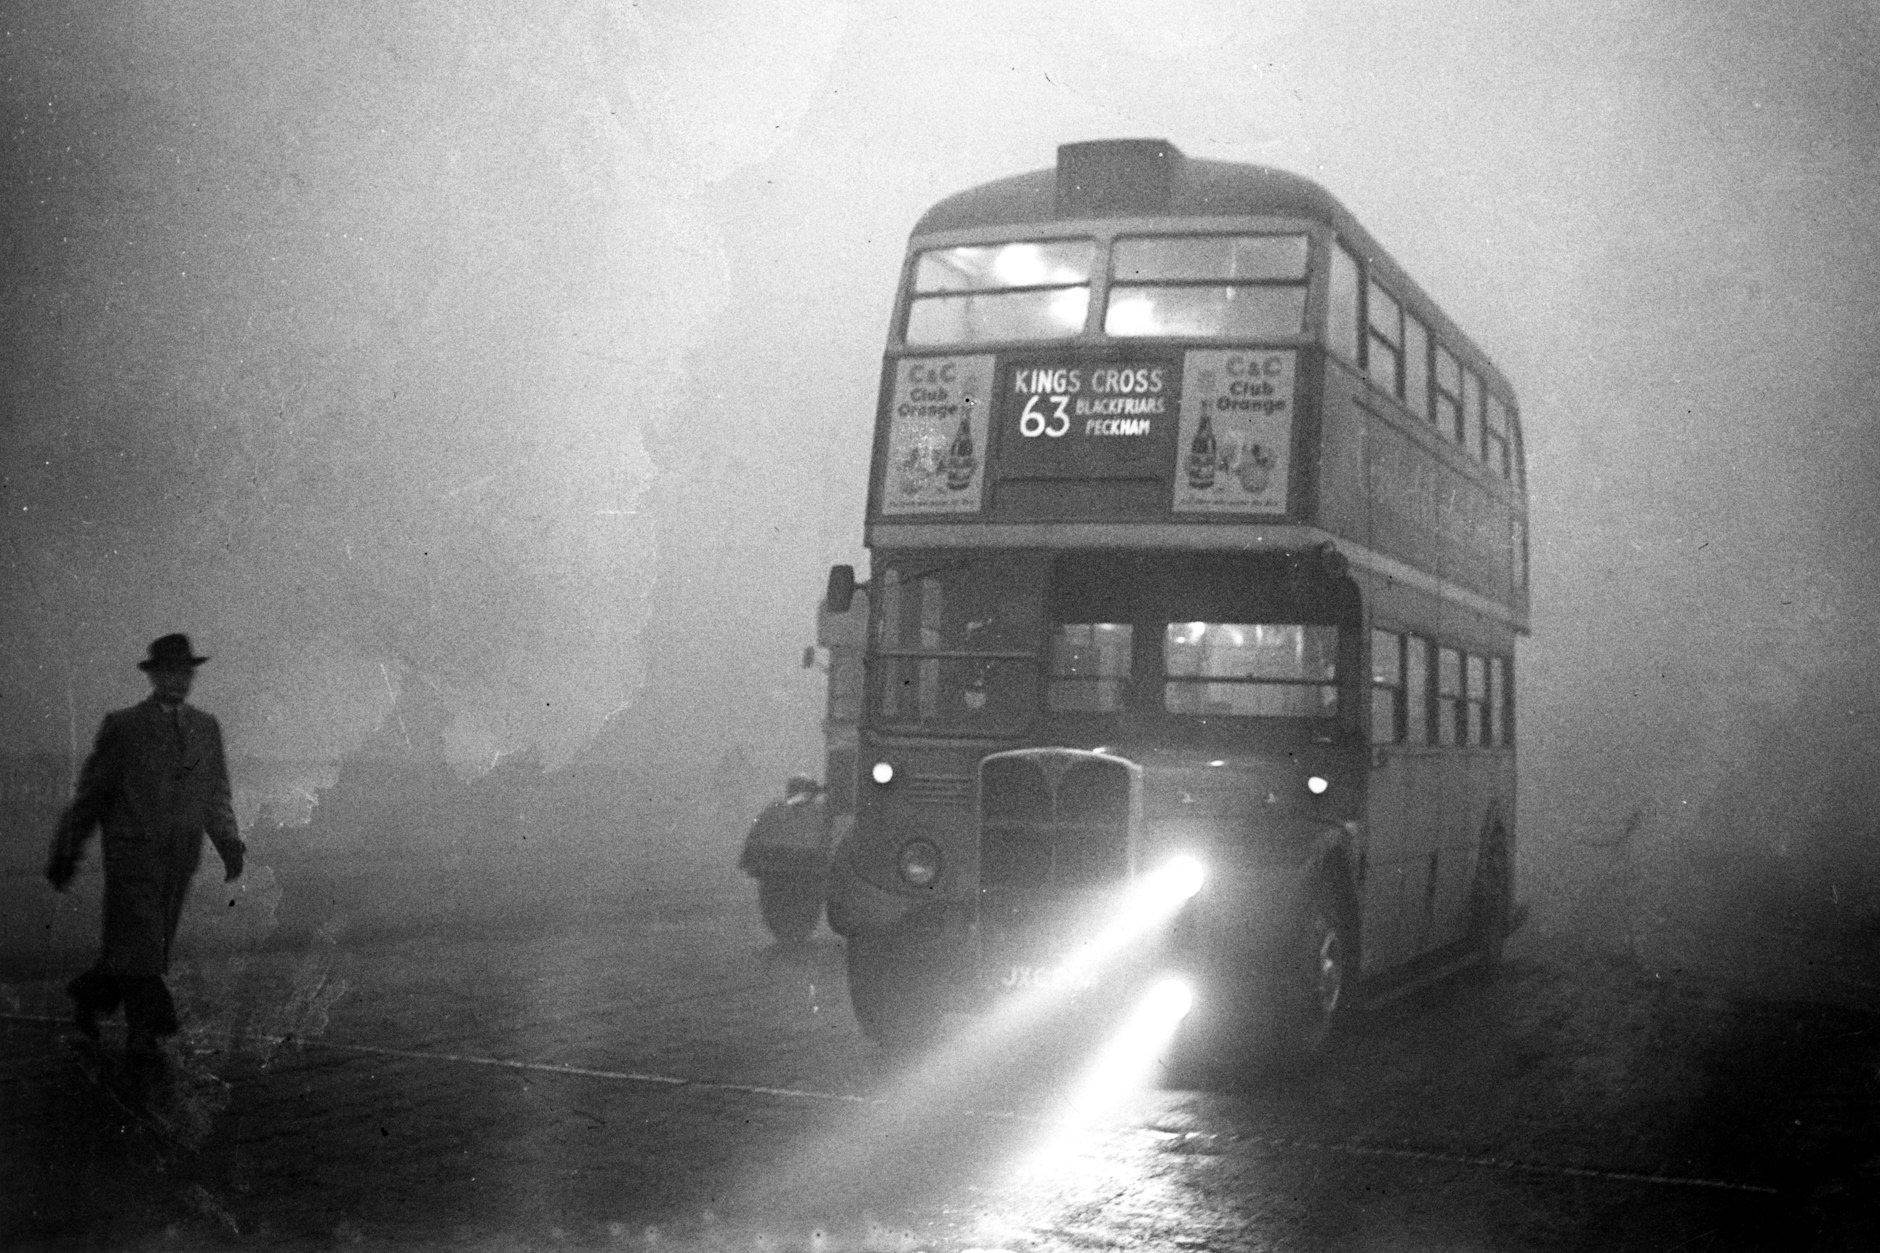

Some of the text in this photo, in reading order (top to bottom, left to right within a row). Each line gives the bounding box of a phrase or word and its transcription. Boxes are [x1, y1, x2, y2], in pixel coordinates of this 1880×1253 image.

[1015, 368, 1163, 394] KINGS CROSS
[1229, 381, 1275, 396] Club
[910, 387, 948, 402] Club
[898, 403, 958, 420] Orange
[1075, 397, 1165, 415] BLACKFRIARS
[1217, 396, 1286, 416] Orange
[1020, 395, 1070, 437] 63
[1085, 418, 1150, 436] PECKHAM
